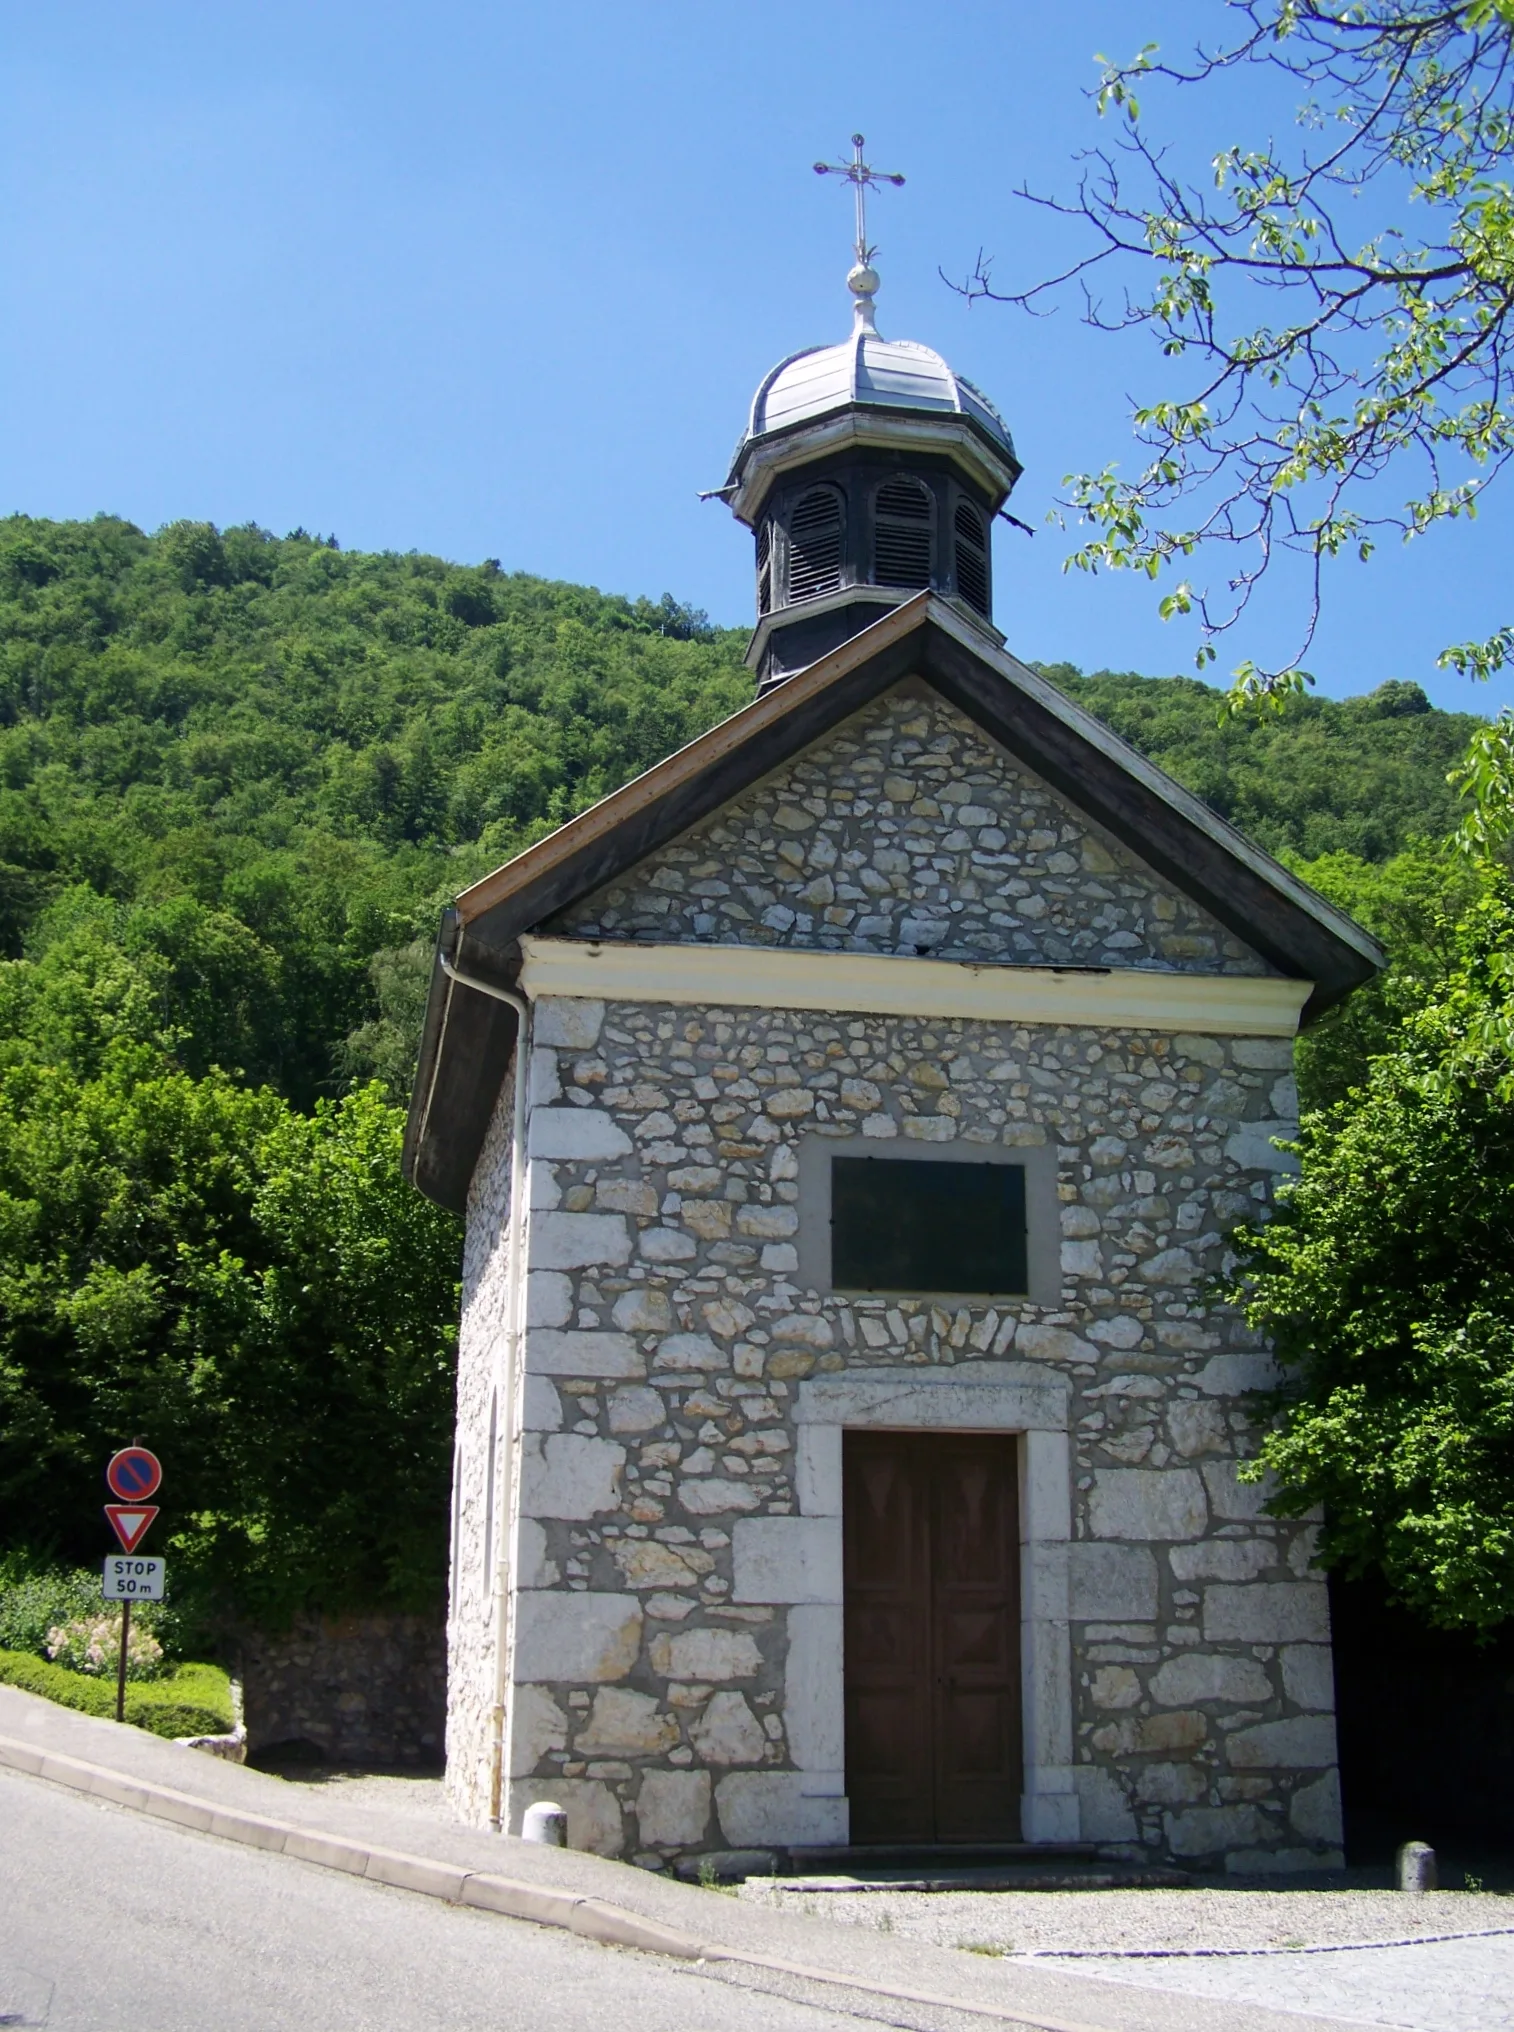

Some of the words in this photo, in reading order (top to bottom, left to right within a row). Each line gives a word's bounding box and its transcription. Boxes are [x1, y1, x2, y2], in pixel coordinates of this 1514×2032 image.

[114, 1561, 156, 1575] STOP
[117, 1579, 136, 1593] 50
[140, 1585, 151, 1593] m
